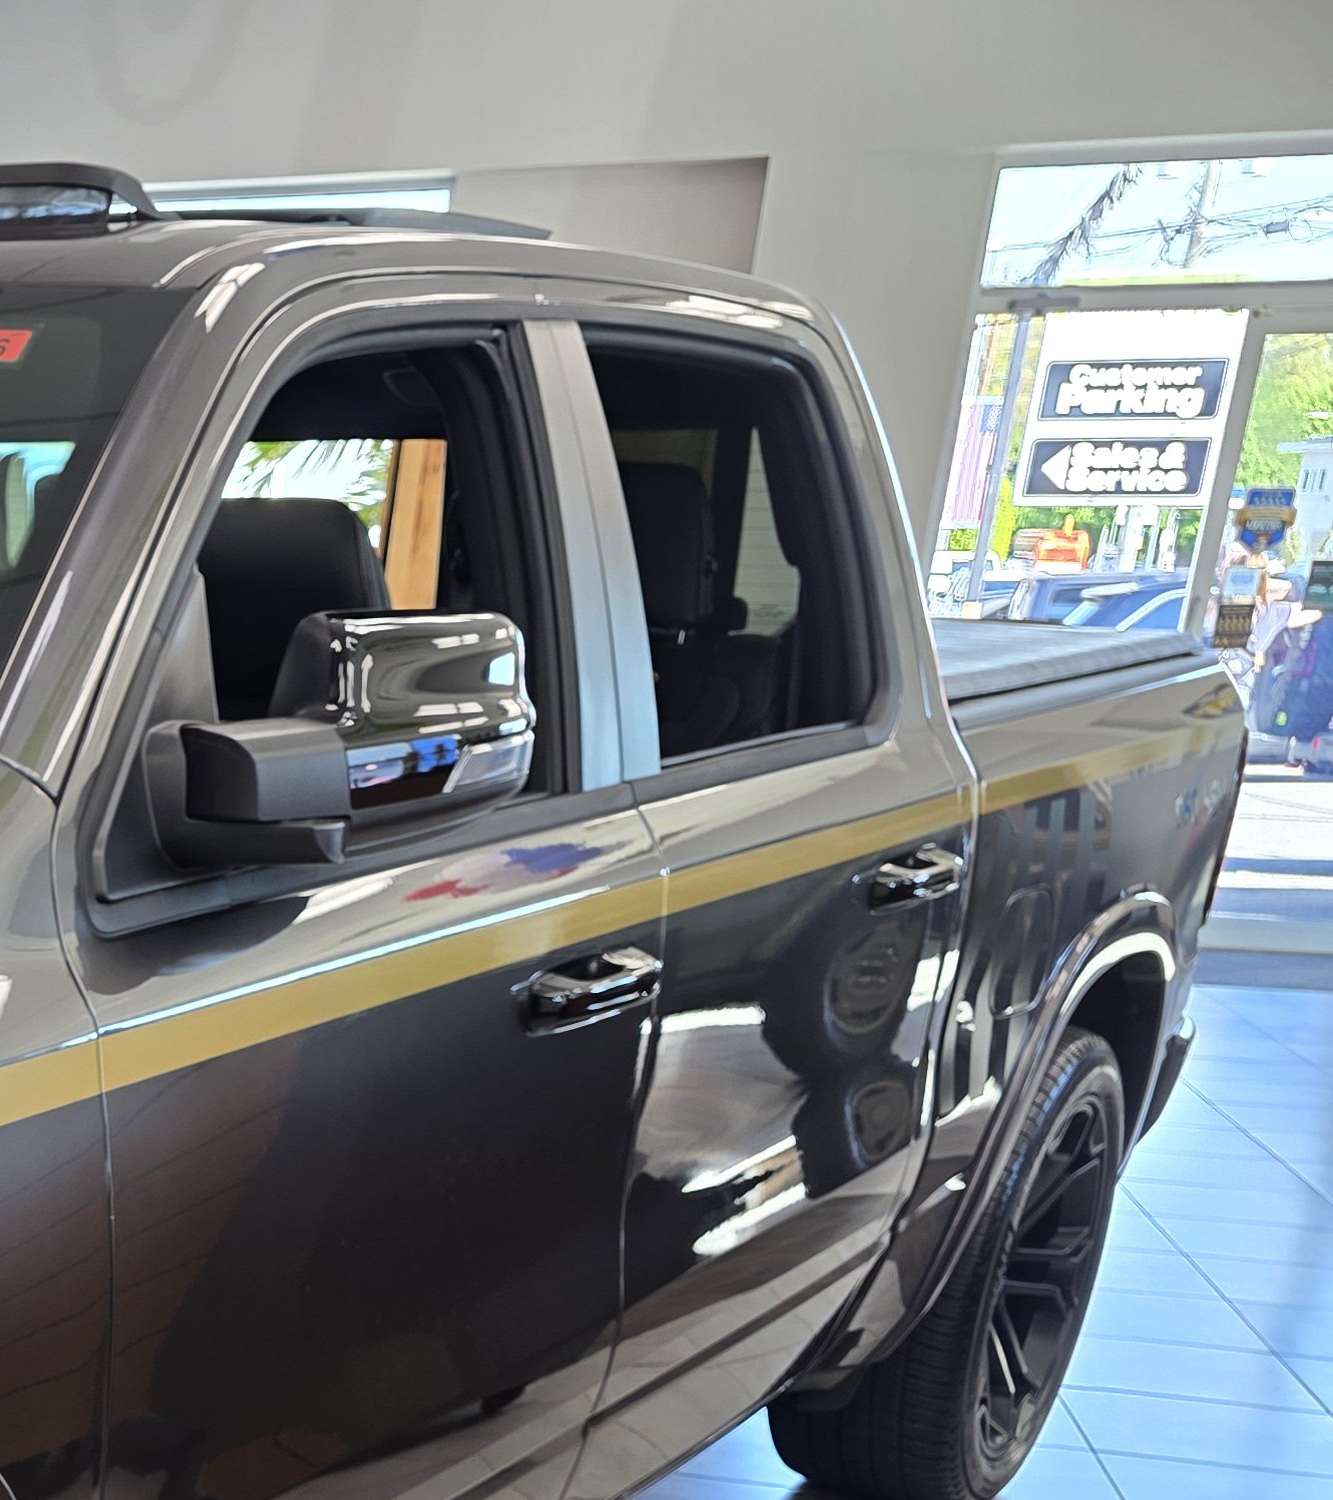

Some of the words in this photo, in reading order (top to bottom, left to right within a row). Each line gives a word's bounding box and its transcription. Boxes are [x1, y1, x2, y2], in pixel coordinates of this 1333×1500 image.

[1069, 363, 1203, 387] Customer
[1055, 380, 1206, 419] Parking
[1070, 441, 1160, 469] Sales
[1065, 467, 1188, 492] Service
